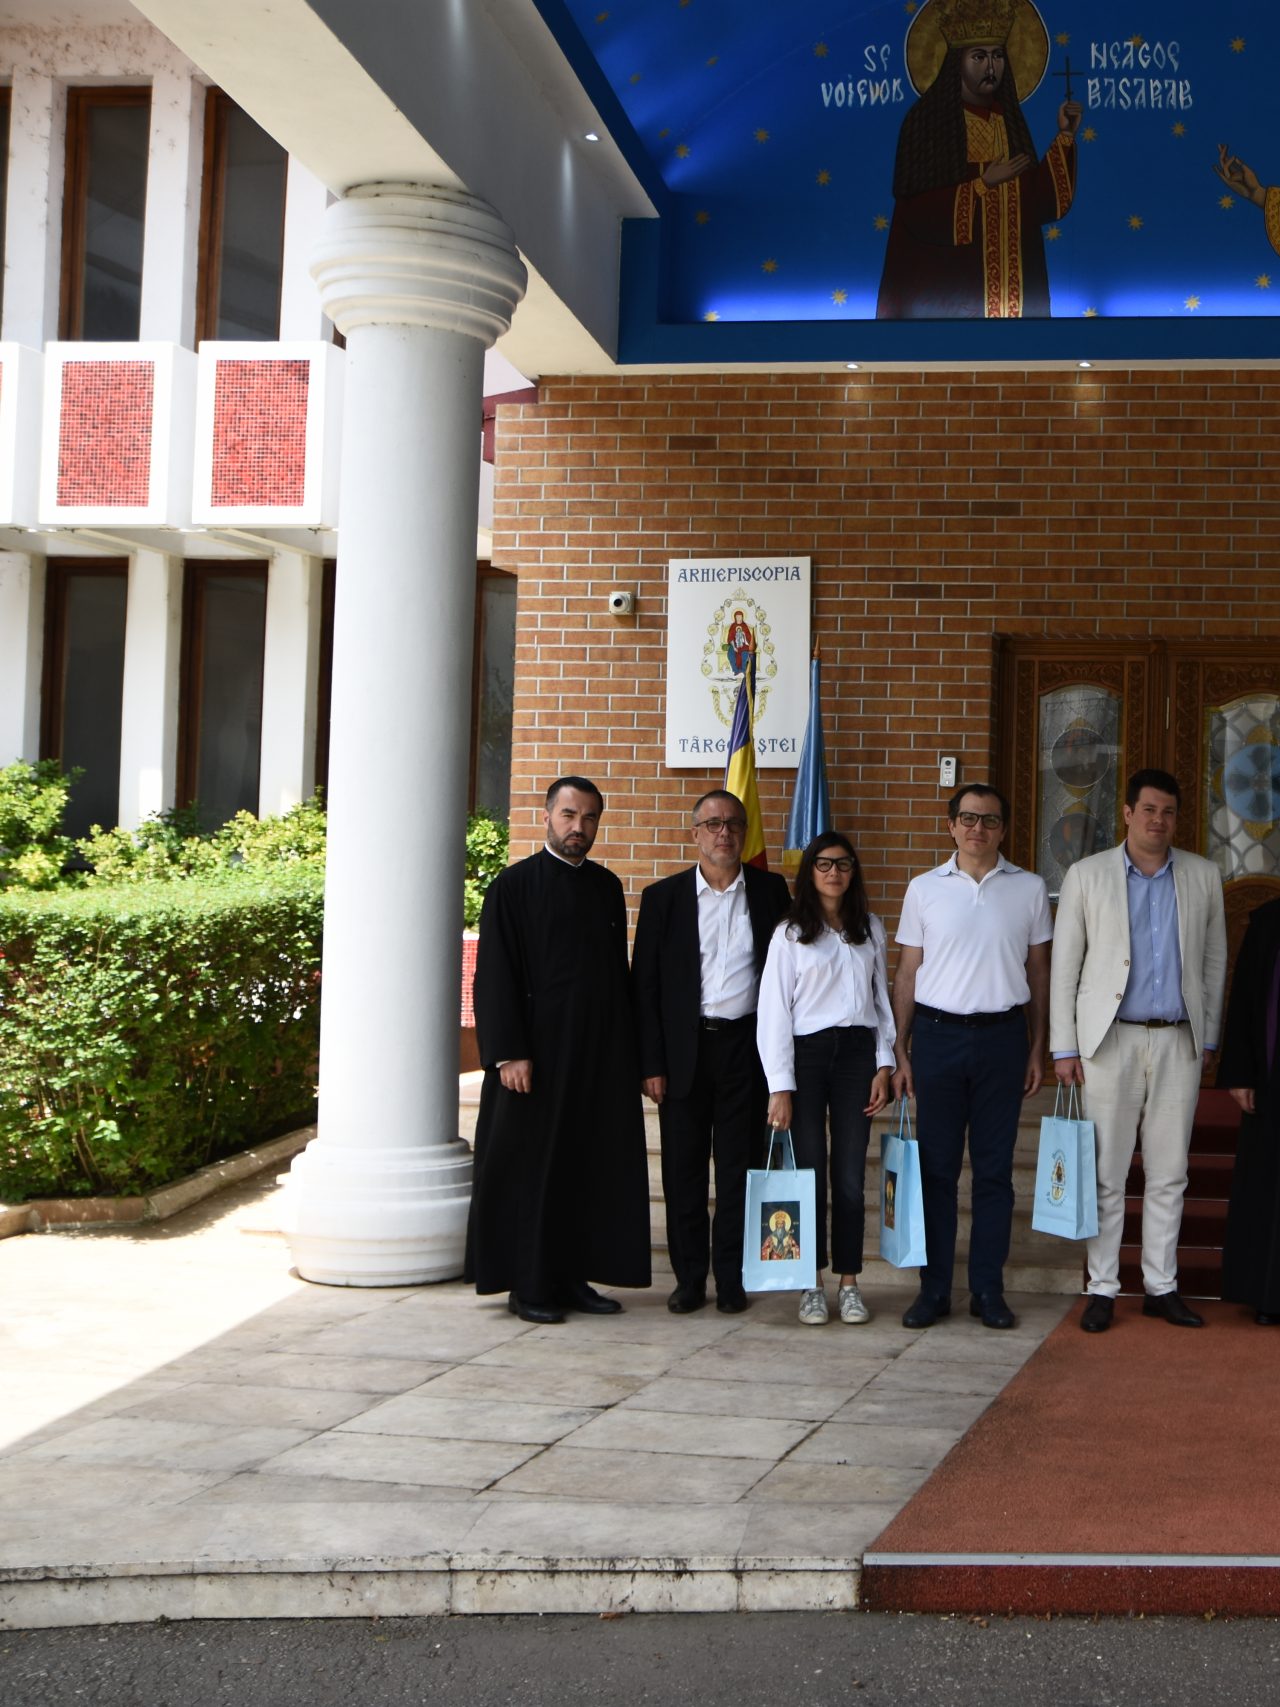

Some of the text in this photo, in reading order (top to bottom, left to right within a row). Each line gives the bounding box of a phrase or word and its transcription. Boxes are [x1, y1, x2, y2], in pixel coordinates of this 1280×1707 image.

[1090, 41, 1180, 72] NEAGOE
[1087, 77, 1193, 110] BASARAB
[678, 566, 801, 583] ARHIEPISCOPIA
[678, 735, 797, 755] TÂRGȘTEI
